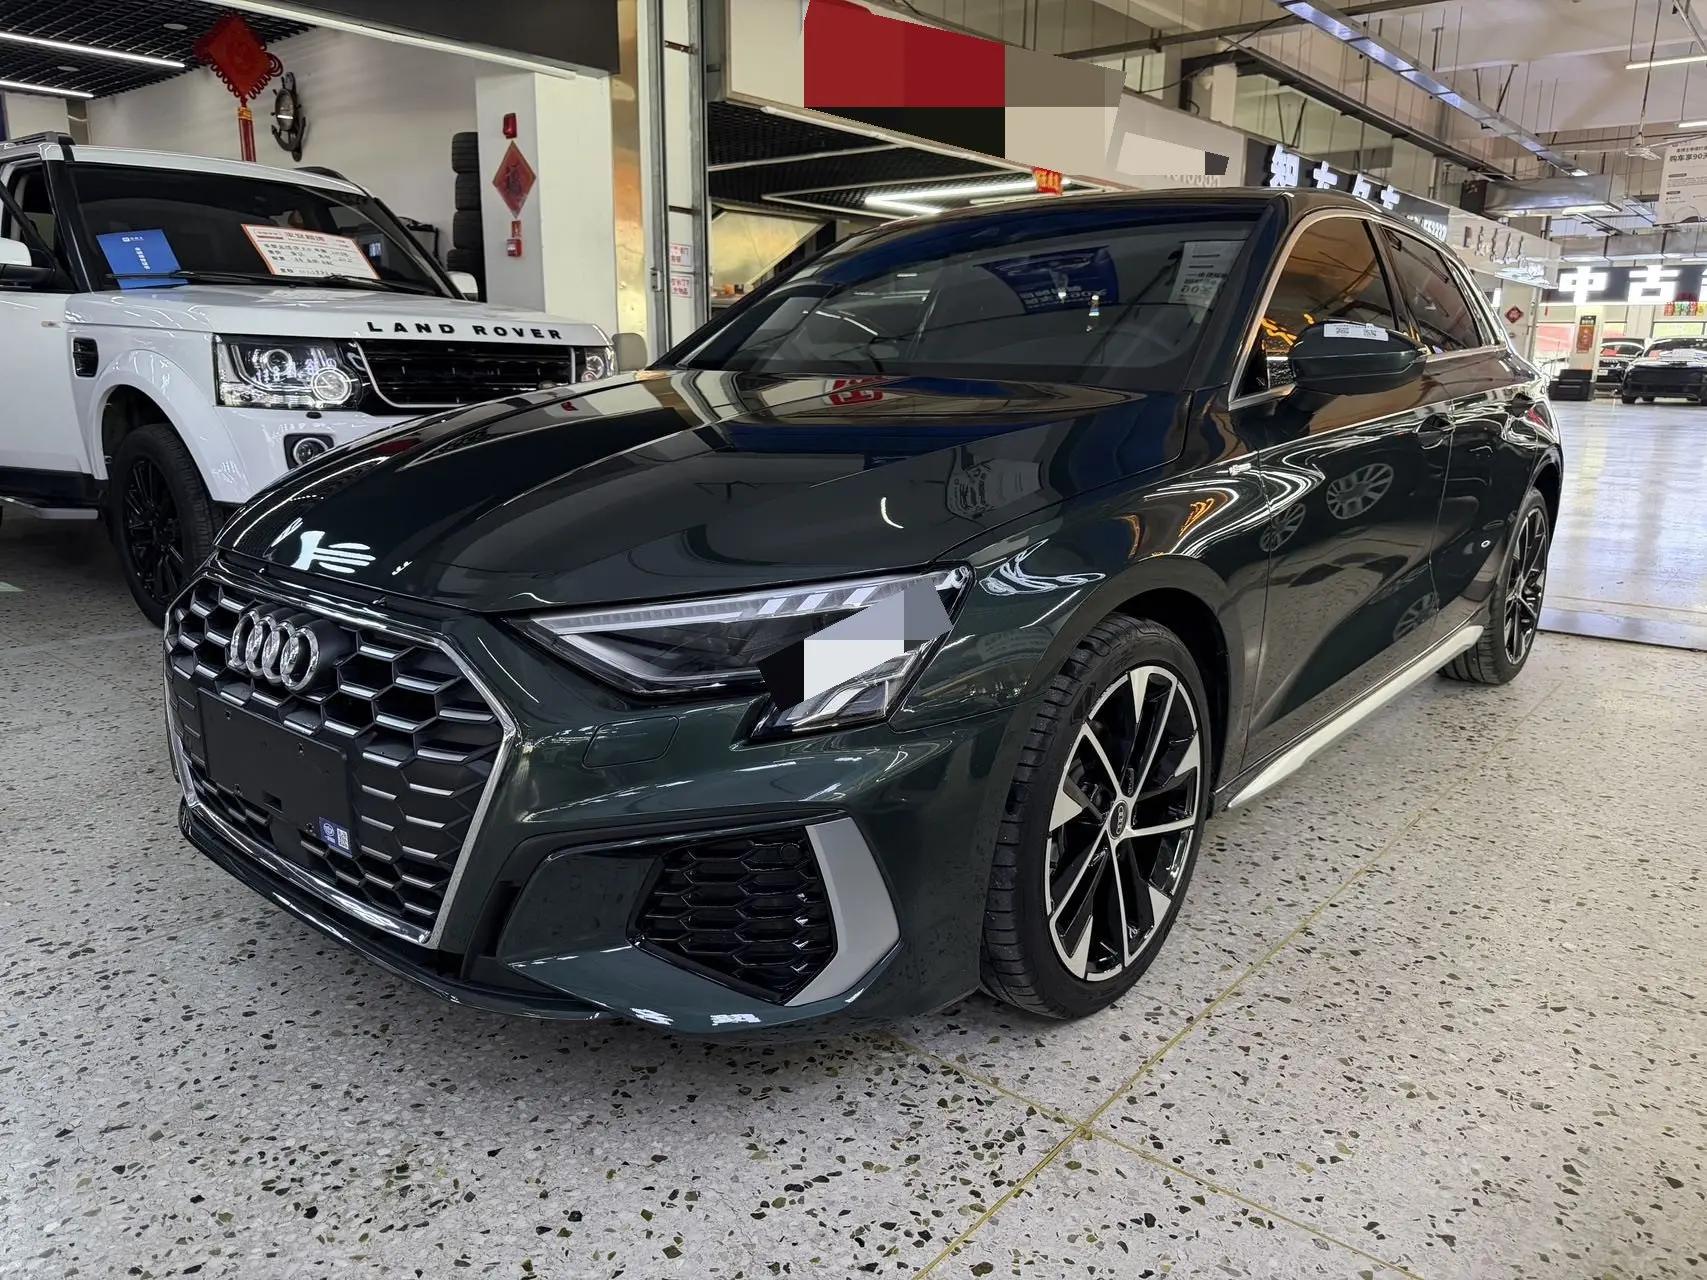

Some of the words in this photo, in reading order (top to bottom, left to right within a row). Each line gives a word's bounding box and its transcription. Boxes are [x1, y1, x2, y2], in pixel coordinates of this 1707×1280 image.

[1558, 264, 1707, 305] 中古
[366, 321, 456, 335] LAND
[471, 324, 563, 340] ROVER
